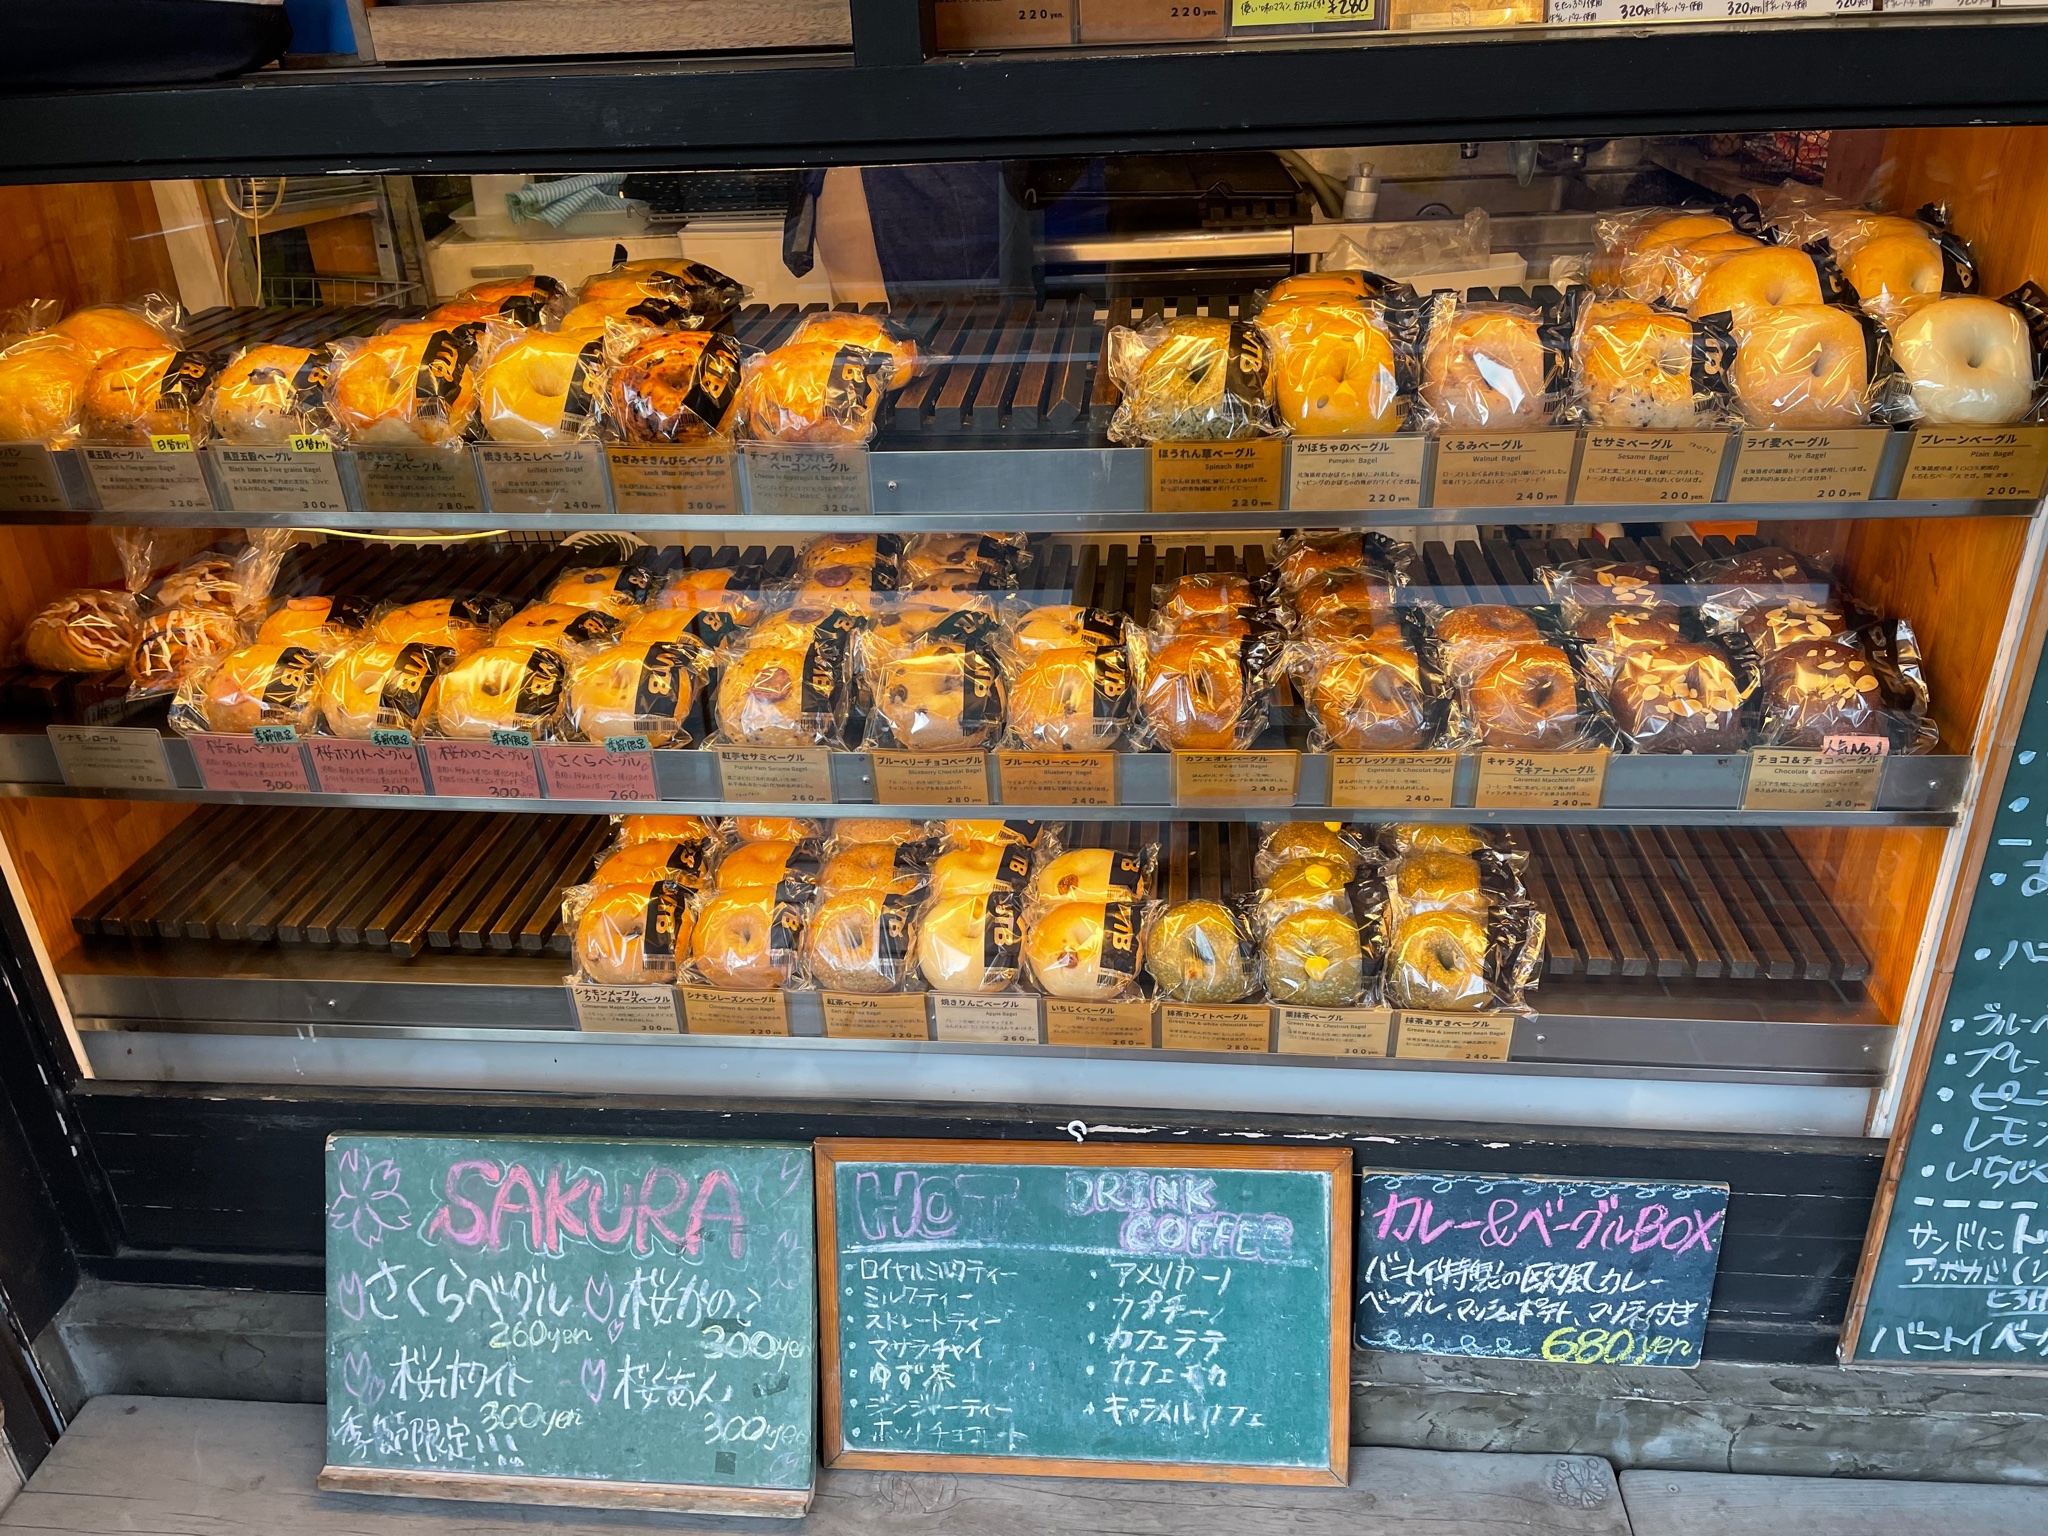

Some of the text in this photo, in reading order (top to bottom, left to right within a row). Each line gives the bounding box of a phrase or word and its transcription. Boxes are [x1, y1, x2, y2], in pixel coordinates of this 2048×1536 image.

[1018, 9, 1047, 20] 220
[1171, 6, 1201, 18] 220
[1591, 437, 1673, 449] セサミベーグル
[1746, 436, 1830, 448] ライ麦ベーグル
[1921, 434, 2017, 446] プレーンベーグル
[1297, 442, 1390, 453] かぼちゃのベーグル
[1445, 440, 1523, 452] くるみベーグル
[1158, 448, 1256, 460] ほうれん草ベーグル
[1473, 454, 1521, 463] Walnut Bagel
[1649, 453, 1670, 462] Bagel
[1787, 452, 1826, 461] Rye Bagel
[1970, 449, 2014, 459] Plain Bagel
[1328, 457, 1377, 466] Pumpkin Bagel
[1205, 462, 1254, 472] Spinach Bagel
[1660, 491, 1688, 500] 200
[1816, 489, 1847, 498] 200
[1987, 486, 2016, 496] 200
[1369, 494, 1395, 503] 220
[1516, 492, 1544, 501] 240
[302, 501, 327, 509] 300
[437, 503, 462, 511] 280
[563, 502, 588, 510] 240
[687, 501, 712, 510] 300
[822, 504, 847, 512] 320
[1232, 499, 1258, 507] 220
[877, 756, 982, 767] ブルーベリーチョコベーグル
[1004, 758, 1099, 767] ブルーベリーベーグル
[1185, 755, 1269, 763] カフェオレベーグル
[1336, 756, 1453, 766] エスプレッソチョコベーグル
[1487, 756, 1535, 767] キャラメル
[1757, 755, 1879, 767] チョコ&チョコベーグル
[1514, 765, 1596, 775] マキアートベーグル
[1774, 768, 1809, 776] Chocolate
[1855, 767, 1875, 776] Bagel
[263, 779, 293, 791] 300
[1251, 785, 1276, 793] 240
[488, 786, 520, 798] 300
[608, 790, 639, 801] 260
[791, 794, 814, 802] 260
[946, 796, 970, 804] 280
[1072, 797, 1095, 805] 240
[1405, 795, 1431, 803] 240
[1552, 799, 1578, 807] 240
[1824, 800, 1852, 809] 240
[574, 988, 640, 998] シナモンメープル
[686, 992, 776, 1004] シナモンレーズンベーグル
[584, 995, 671, 1005] クリームチーズベーグル
[826, 997, 878, 1009] 紅茶ベーグル
[940, 998, 1019, 1009] 焼きりんごベーグル
[1051, 1005, 1115, 1016] いちじくベーグル
[1166, 1009, 1248, 1020] 抹茶ホワイトベーグル
[1405, 1016, 1490, 1028] 抹茶あずきベーグル
[1964, 1041, 2048, 1078] プレー
[1066, 1170, 1217, 1217] DRINK
[427, 1157, 748, 1260] SAKURA
[1373, 1193, 1722, 1254] カレー&ベーグルBOX
[1120, 1211, 1294, 1262] COFFEE
[863, 1285, 974, 1310] ミルクティー
[1106, 1329, 1227, 1361] カフェラテ
[869, 1362, 956, 1393] ゆず茶
